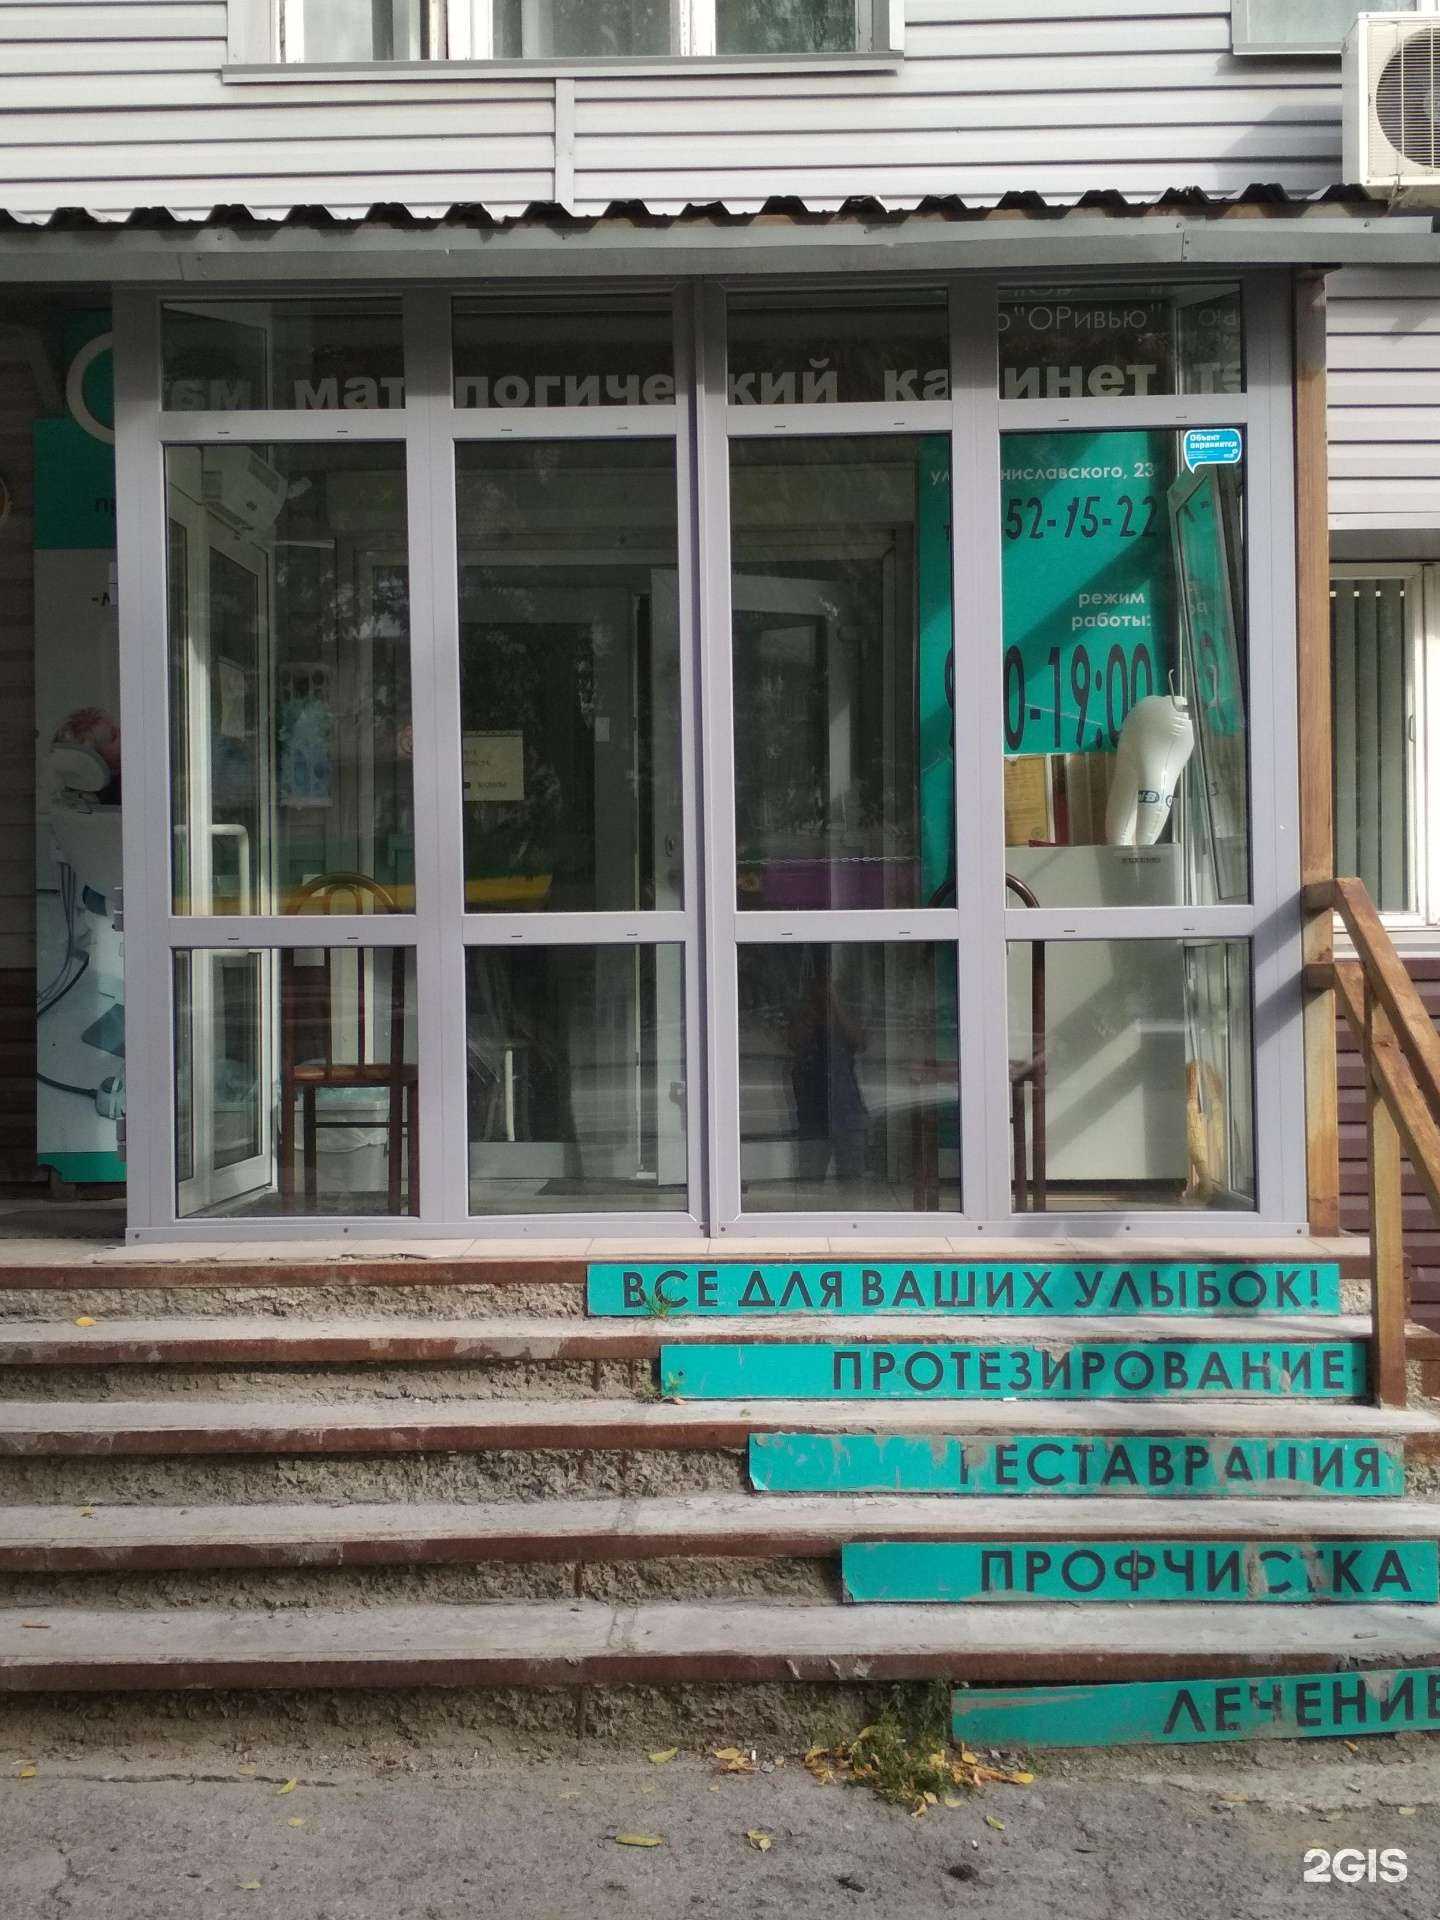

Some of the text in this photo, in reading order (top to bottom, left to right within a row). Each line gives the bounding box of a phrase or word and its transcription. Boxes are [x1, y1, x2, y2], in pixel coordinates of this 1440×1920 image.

[883, 364, 1157, 402] каинет
[1000, 466, 1127, 481] ниславского,
[1078, 592, 1145, 606] режим
[1071, 613, 1151, 631] работы:
[623, 1269, 1320, 1308] ВСЕ ДЛЯ ВАШИХ УЛЫБОК!
[833, 1350, 1345, 1391] ПРОТЕЗИРОВАНИЕ
